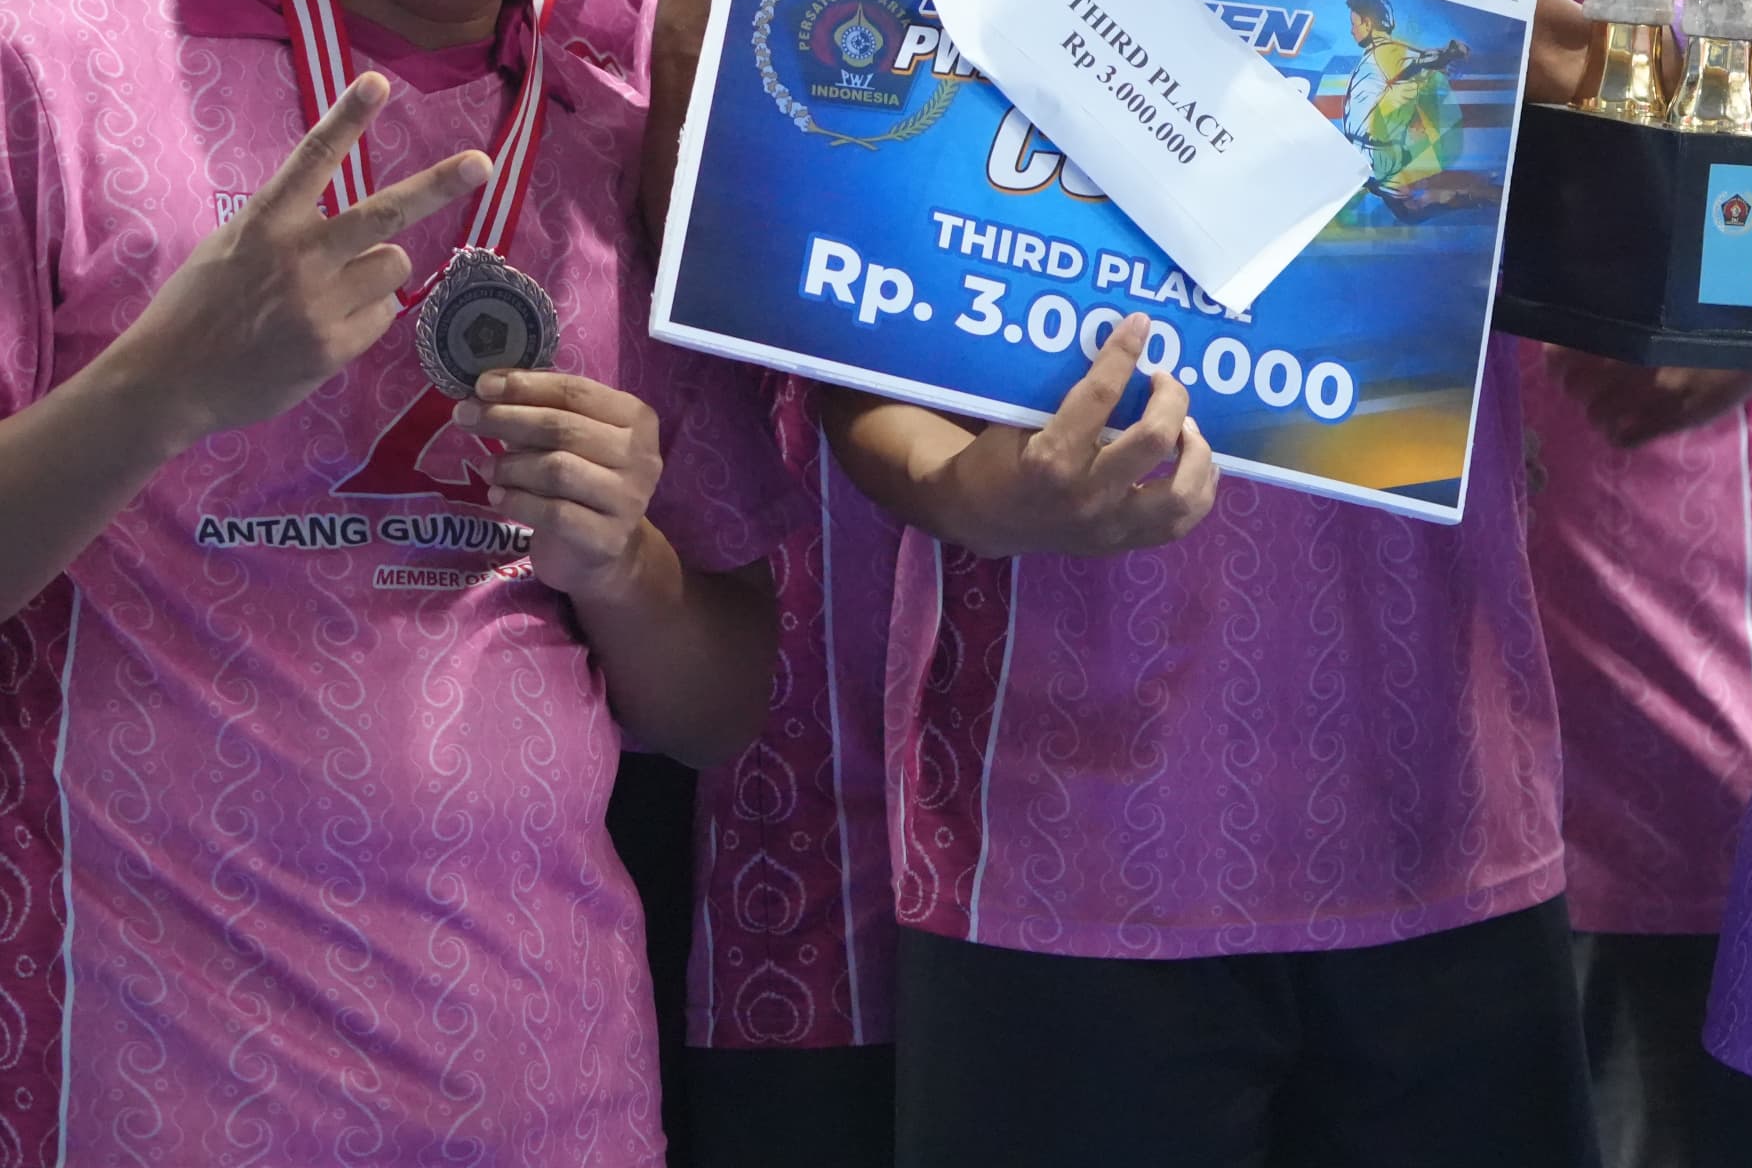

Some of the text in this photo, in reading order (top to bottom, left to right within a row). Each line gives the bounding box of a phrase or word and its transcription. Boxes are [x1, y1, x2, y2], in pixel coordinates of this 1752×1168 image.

[811, 84, 900, 106] INDONESIA
[1061, 31, 1096, 69] Rp
[1096, 65, 1197, 165] 3.000.000
[1148, 66, 1235, 154] PLACE
[933, 212, 1084, 279] THIRD
[804, 237, 1354, 420] Rp. 3.000.000
[199, 516, 533, 554] ANTANG GUNUNG
[376, 568, 460, 587] MEMBER
[465, 573, 489, 585] OF
